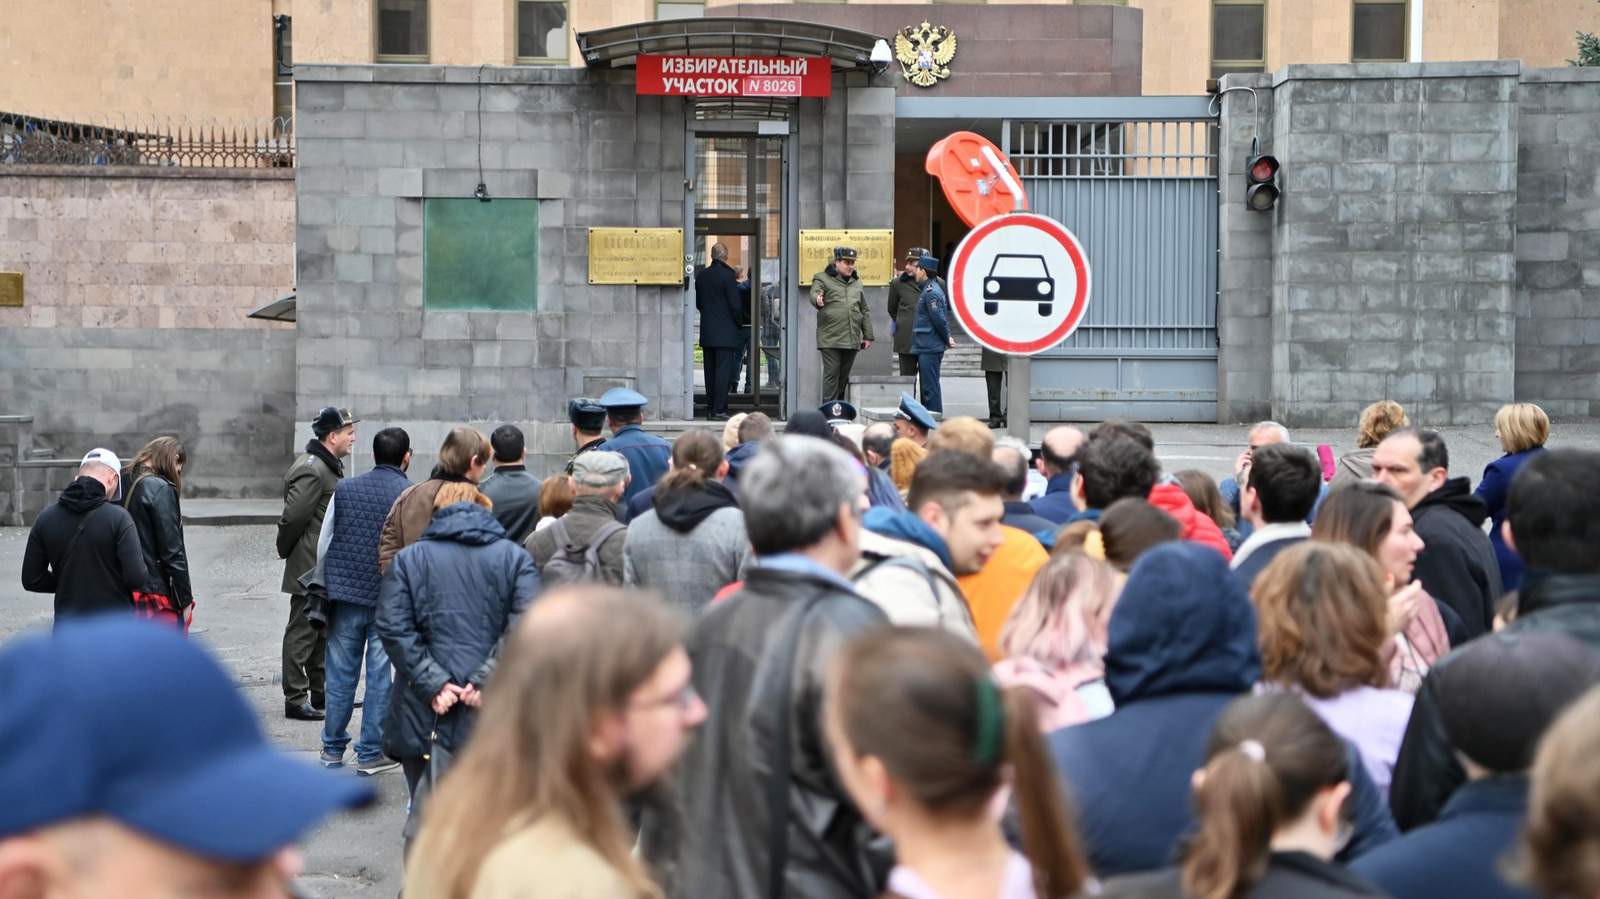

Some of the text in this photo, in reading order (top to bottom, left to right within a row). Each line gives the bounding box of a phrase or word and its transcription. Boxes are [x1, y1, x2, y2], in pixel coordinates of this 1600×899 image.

[662, 57, 807, 75] ИЗБИРАТЕЛЬНЫЙ
[662, 77, 796, 94] УЧАСТОК N 8026
